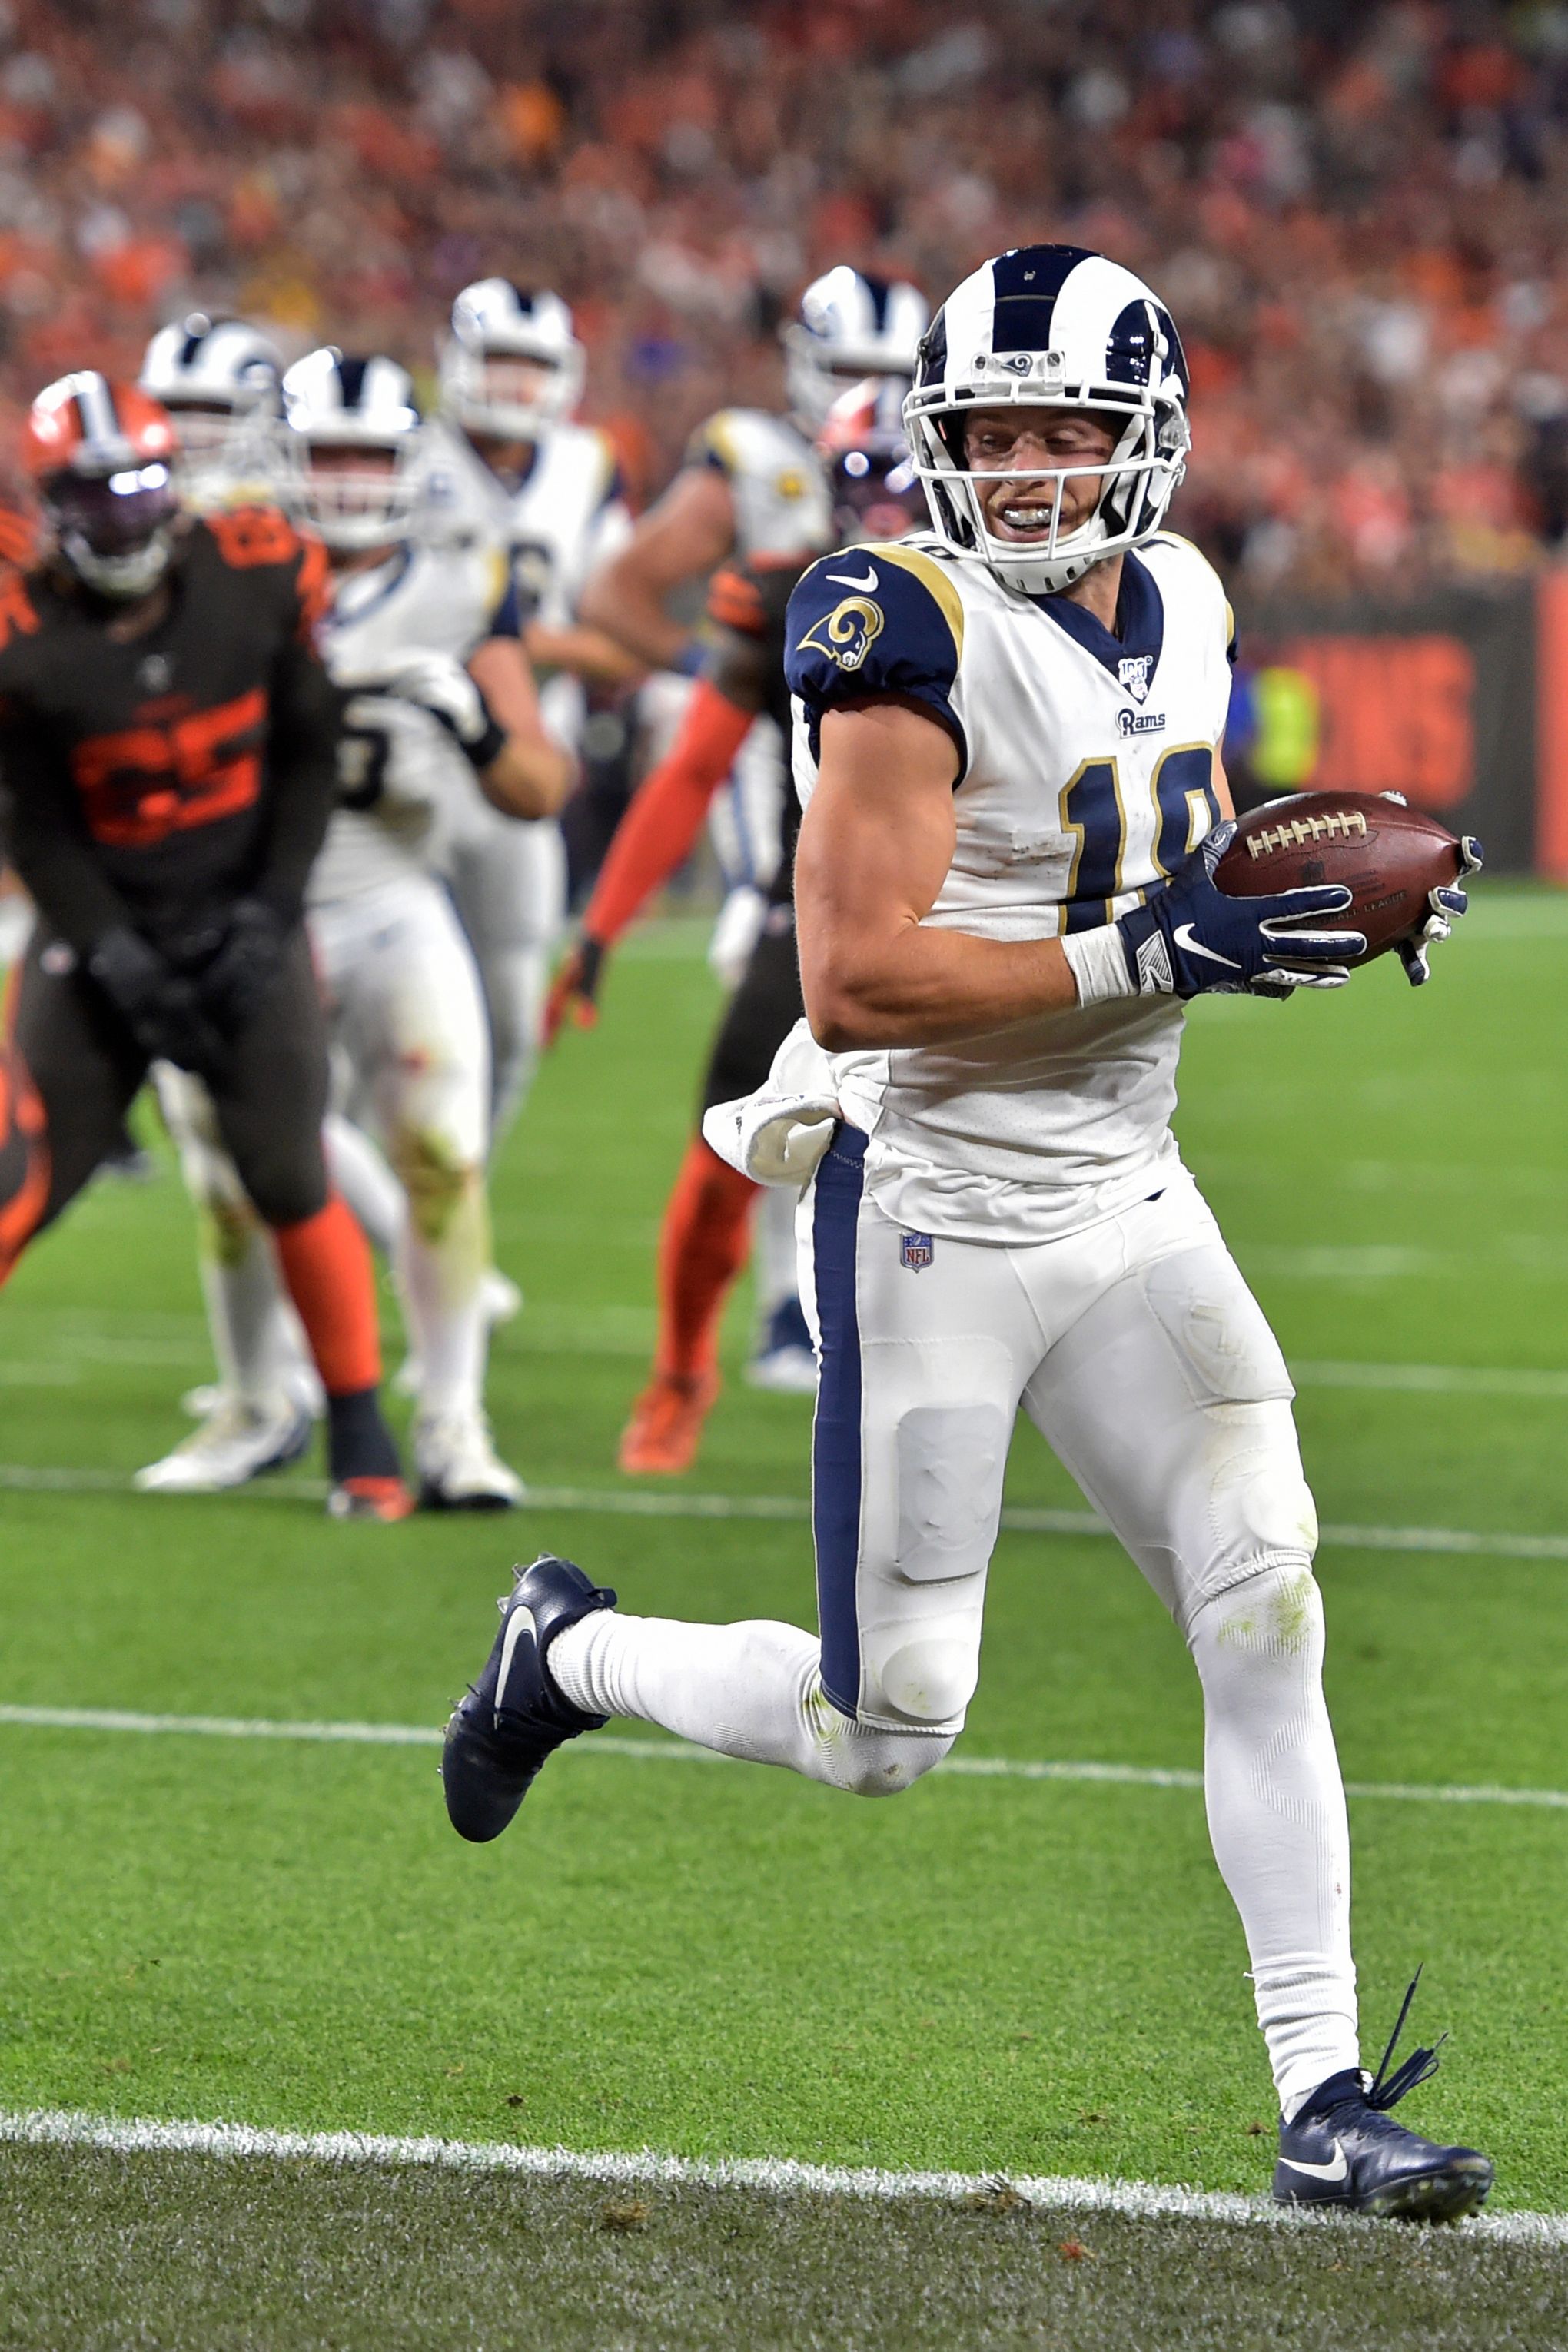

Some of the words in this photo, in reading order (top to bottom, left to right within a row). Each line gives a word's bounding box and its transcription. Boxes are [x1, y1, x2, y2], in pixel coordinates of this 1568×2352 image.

[1118, 707, 1165, 736] Rams
[1364, 889, 1408, 913] LEAGUE
[907, 1248, 929, 1264] NFL
